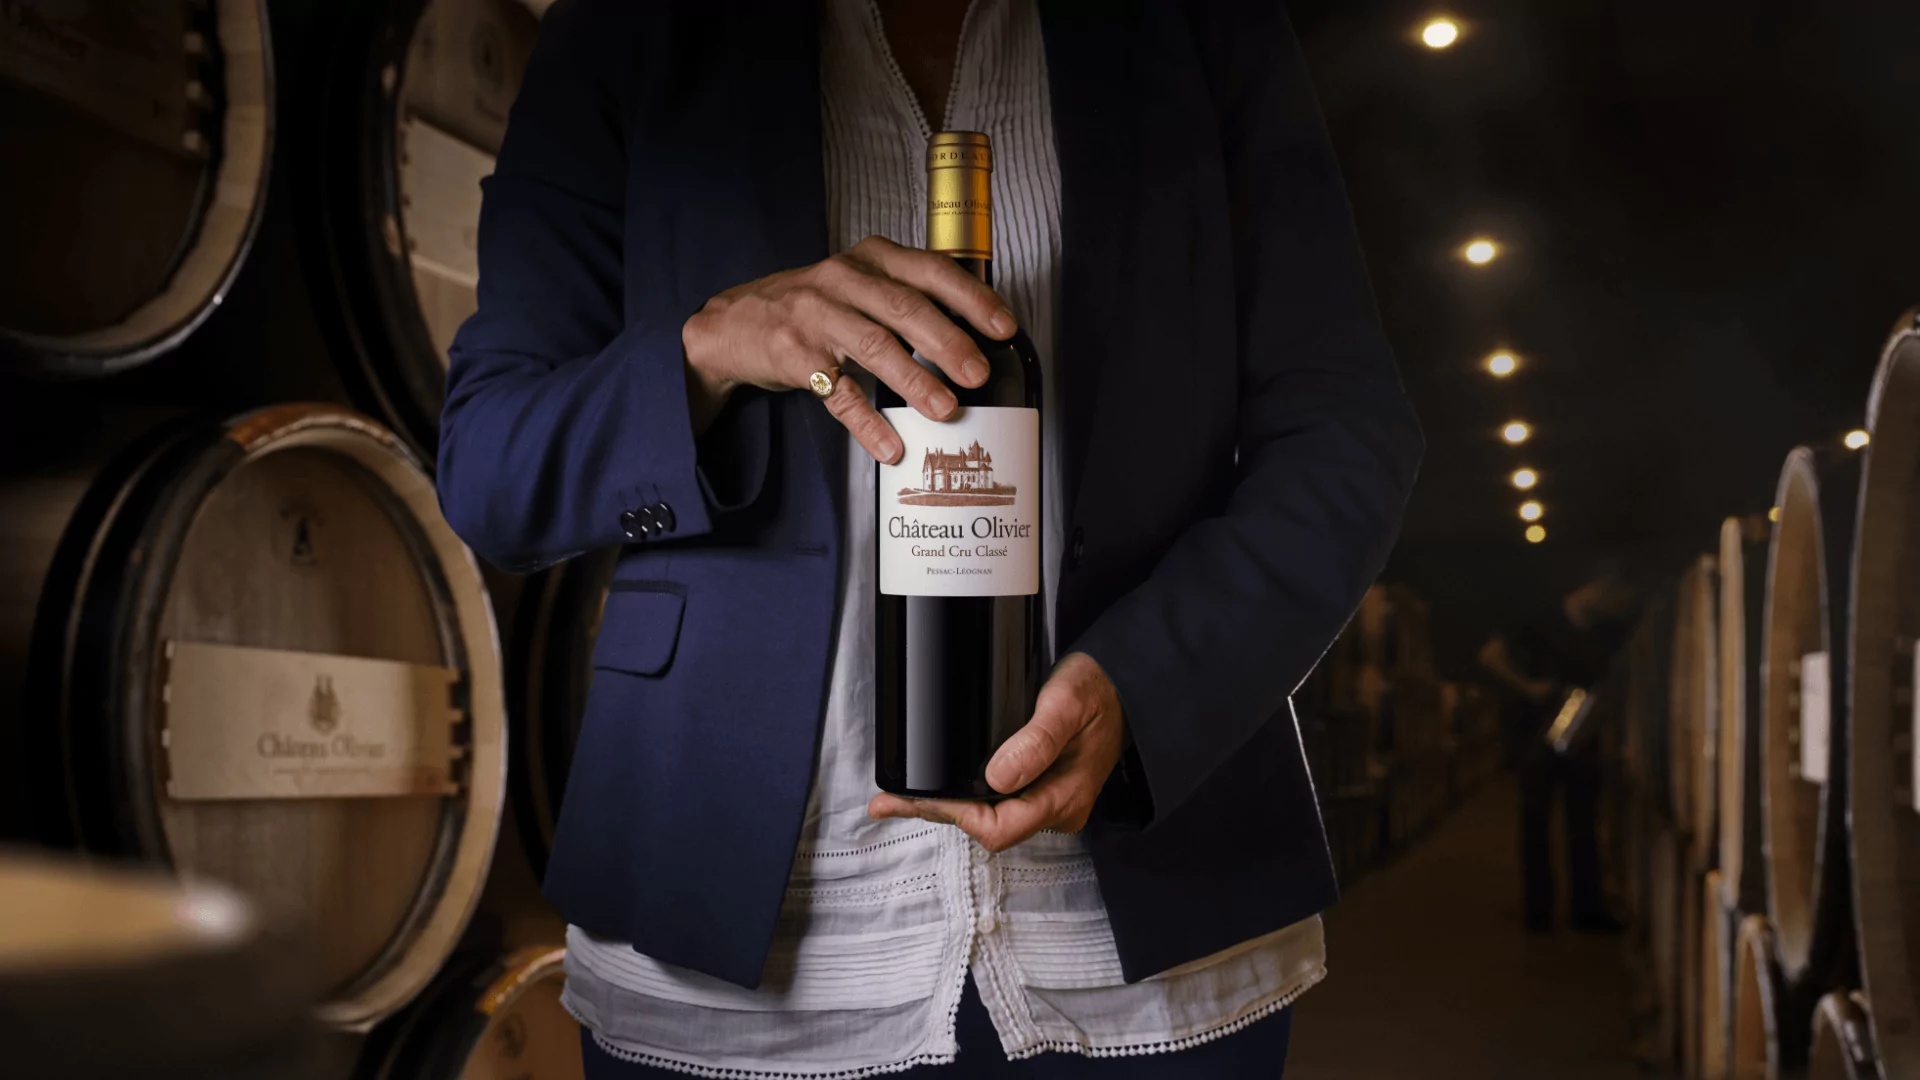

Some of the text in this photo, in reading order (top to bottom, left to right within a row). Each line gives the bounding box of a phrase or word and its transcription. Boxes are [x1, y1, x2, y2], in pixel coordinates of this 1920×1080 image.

[931, 152, 990, 161] ORDEAU
[888, 515, 1032, 539] Château Olivier
[911, 545, 1008, 557] Grand Cru Classé
